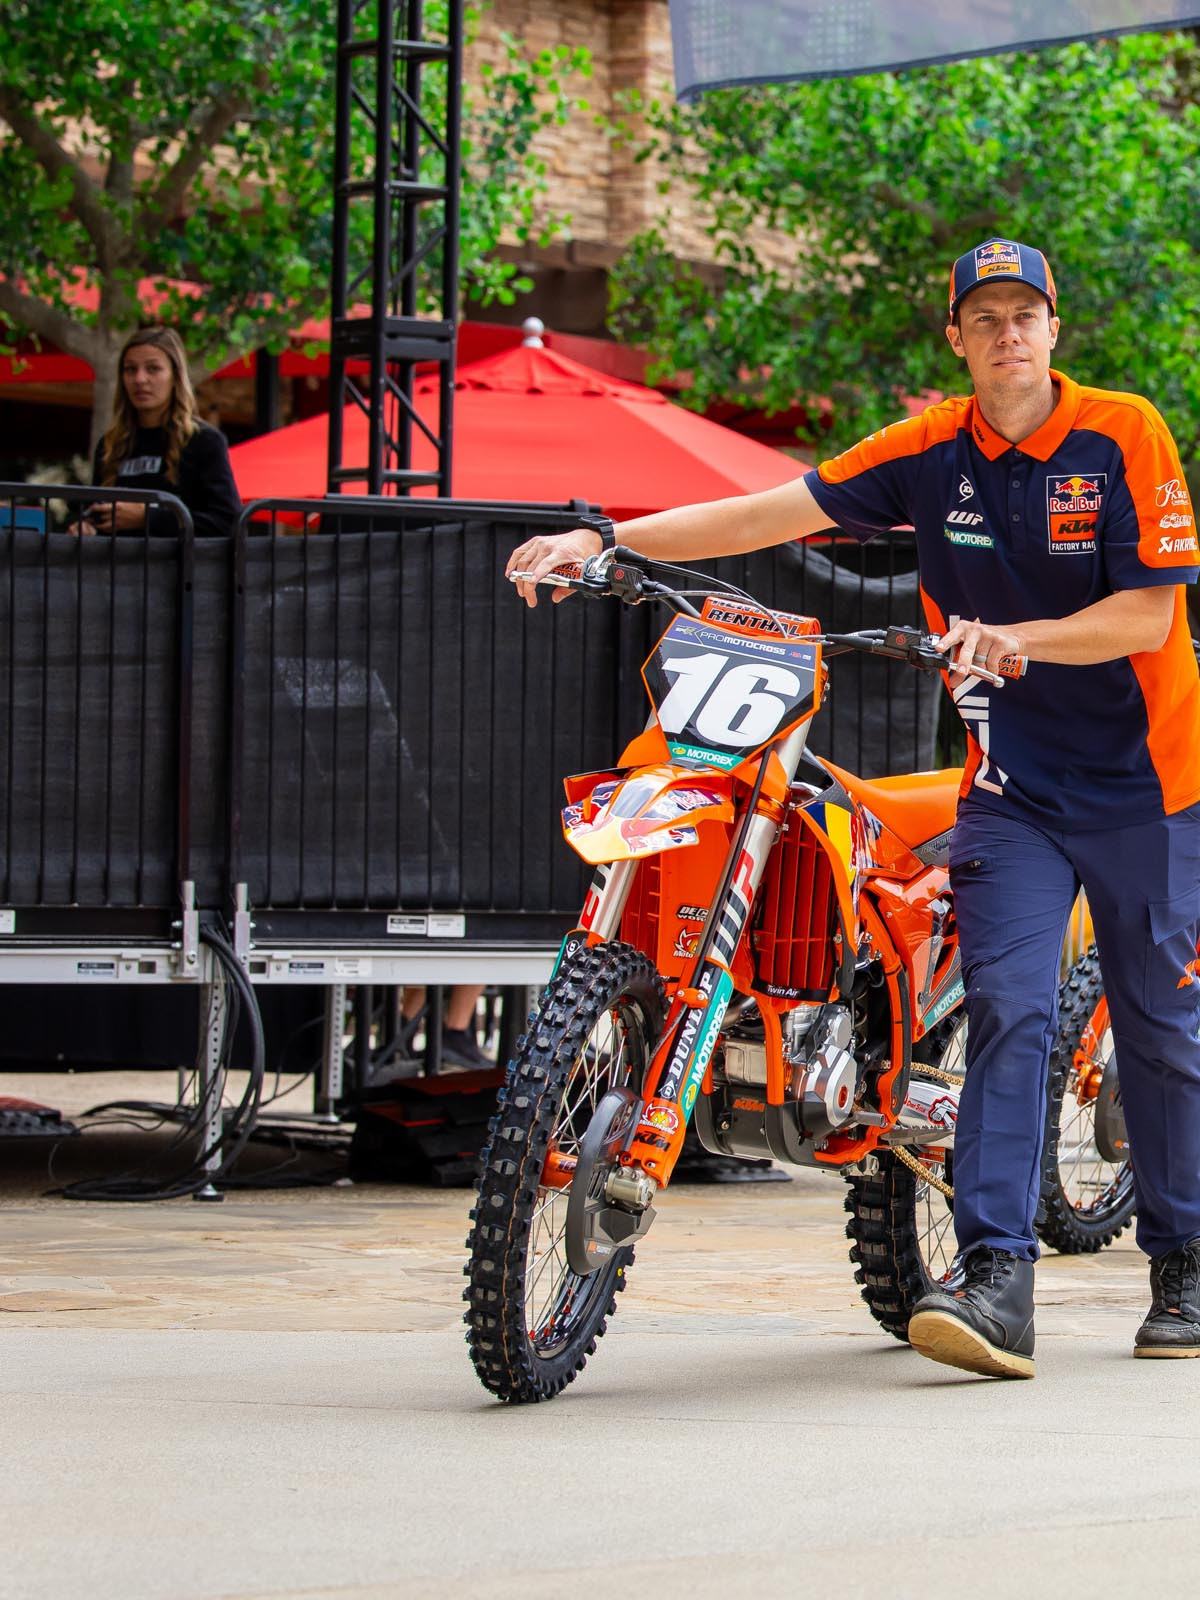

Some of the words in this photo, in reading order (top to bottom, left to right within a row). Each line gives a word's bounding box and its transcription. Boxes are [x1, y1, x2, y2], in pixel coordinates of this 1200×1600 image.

[978, 254, 997, 267] Red
[998, 254, 1019, 263] Bull
[1050, 497, 1076, 512] Red
[1078, 495, 1103, 511] Bul
[1058, 519, 1096, 534] KTM
[950, 532, 992, 546] MOTORE
[1052, 543, 1080, 551] FACTORY
[707, 608, 801, 637] RENTHAL
[657, 653, 801, 747] 16
[687, 748, 735, 767] MOTOREX
[767, 985, 785, 995] Twin
[785, 988, 799, 997] Air
[933, 985, 963, 1018] MOTORE
[690, 994, 729, 1083] MOTOREX
[633, 1131, 671, 1152] KTM
